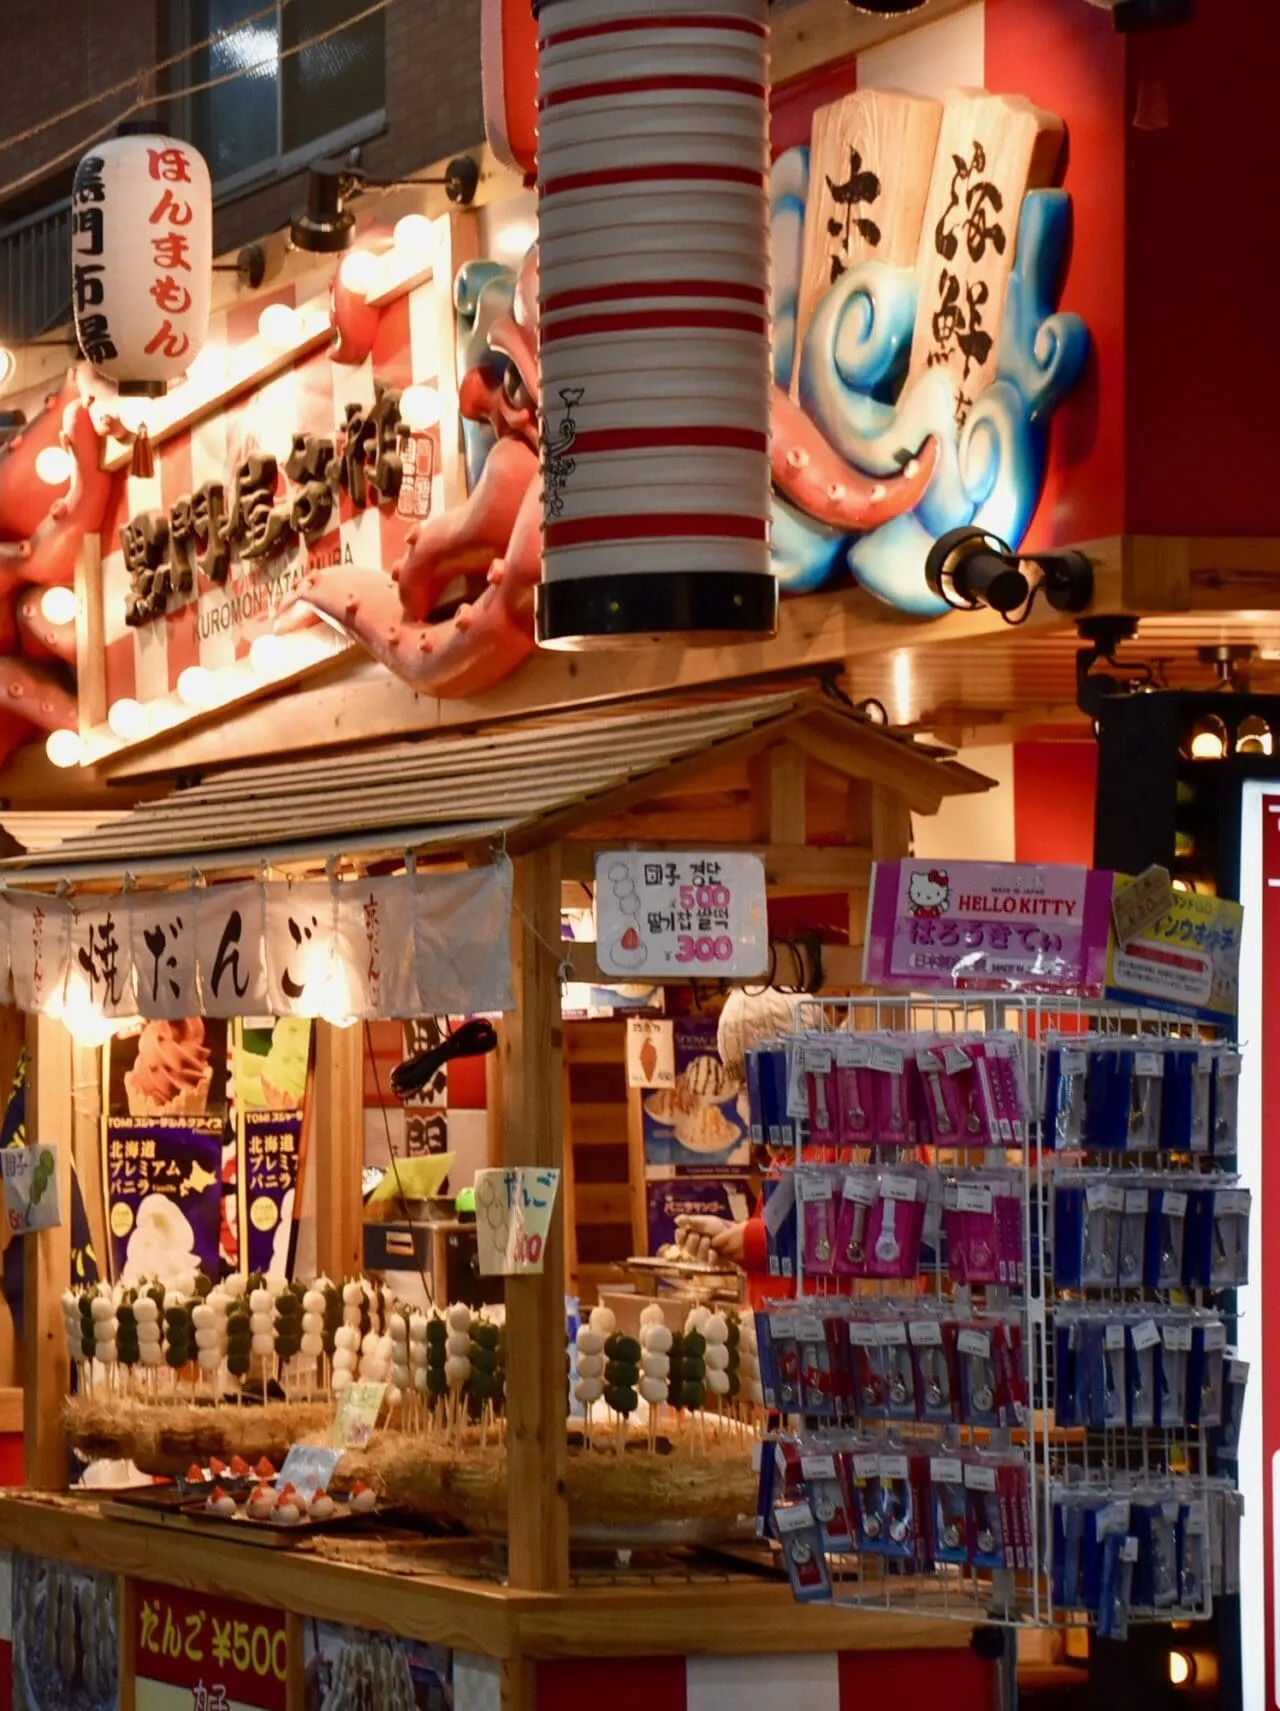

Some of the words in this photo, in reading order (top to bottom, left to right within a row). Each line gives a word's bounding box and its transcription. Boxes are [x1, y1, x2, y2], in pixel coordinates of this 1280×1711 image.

[144, 149, 193, 357] ほんまもん
[958, 894, 1017, 912] HELLO
[1019, 899, 1077, 916] KITTY
[78, 910, 318, 1008] 焼だんご
[109, 1140, 157, 1159] 北海道
[248, 1134, 295, 1154] 北海道
[110, 1160, 181, 1177] プレミアム
[140, 1600, 206, 1661] だんご
